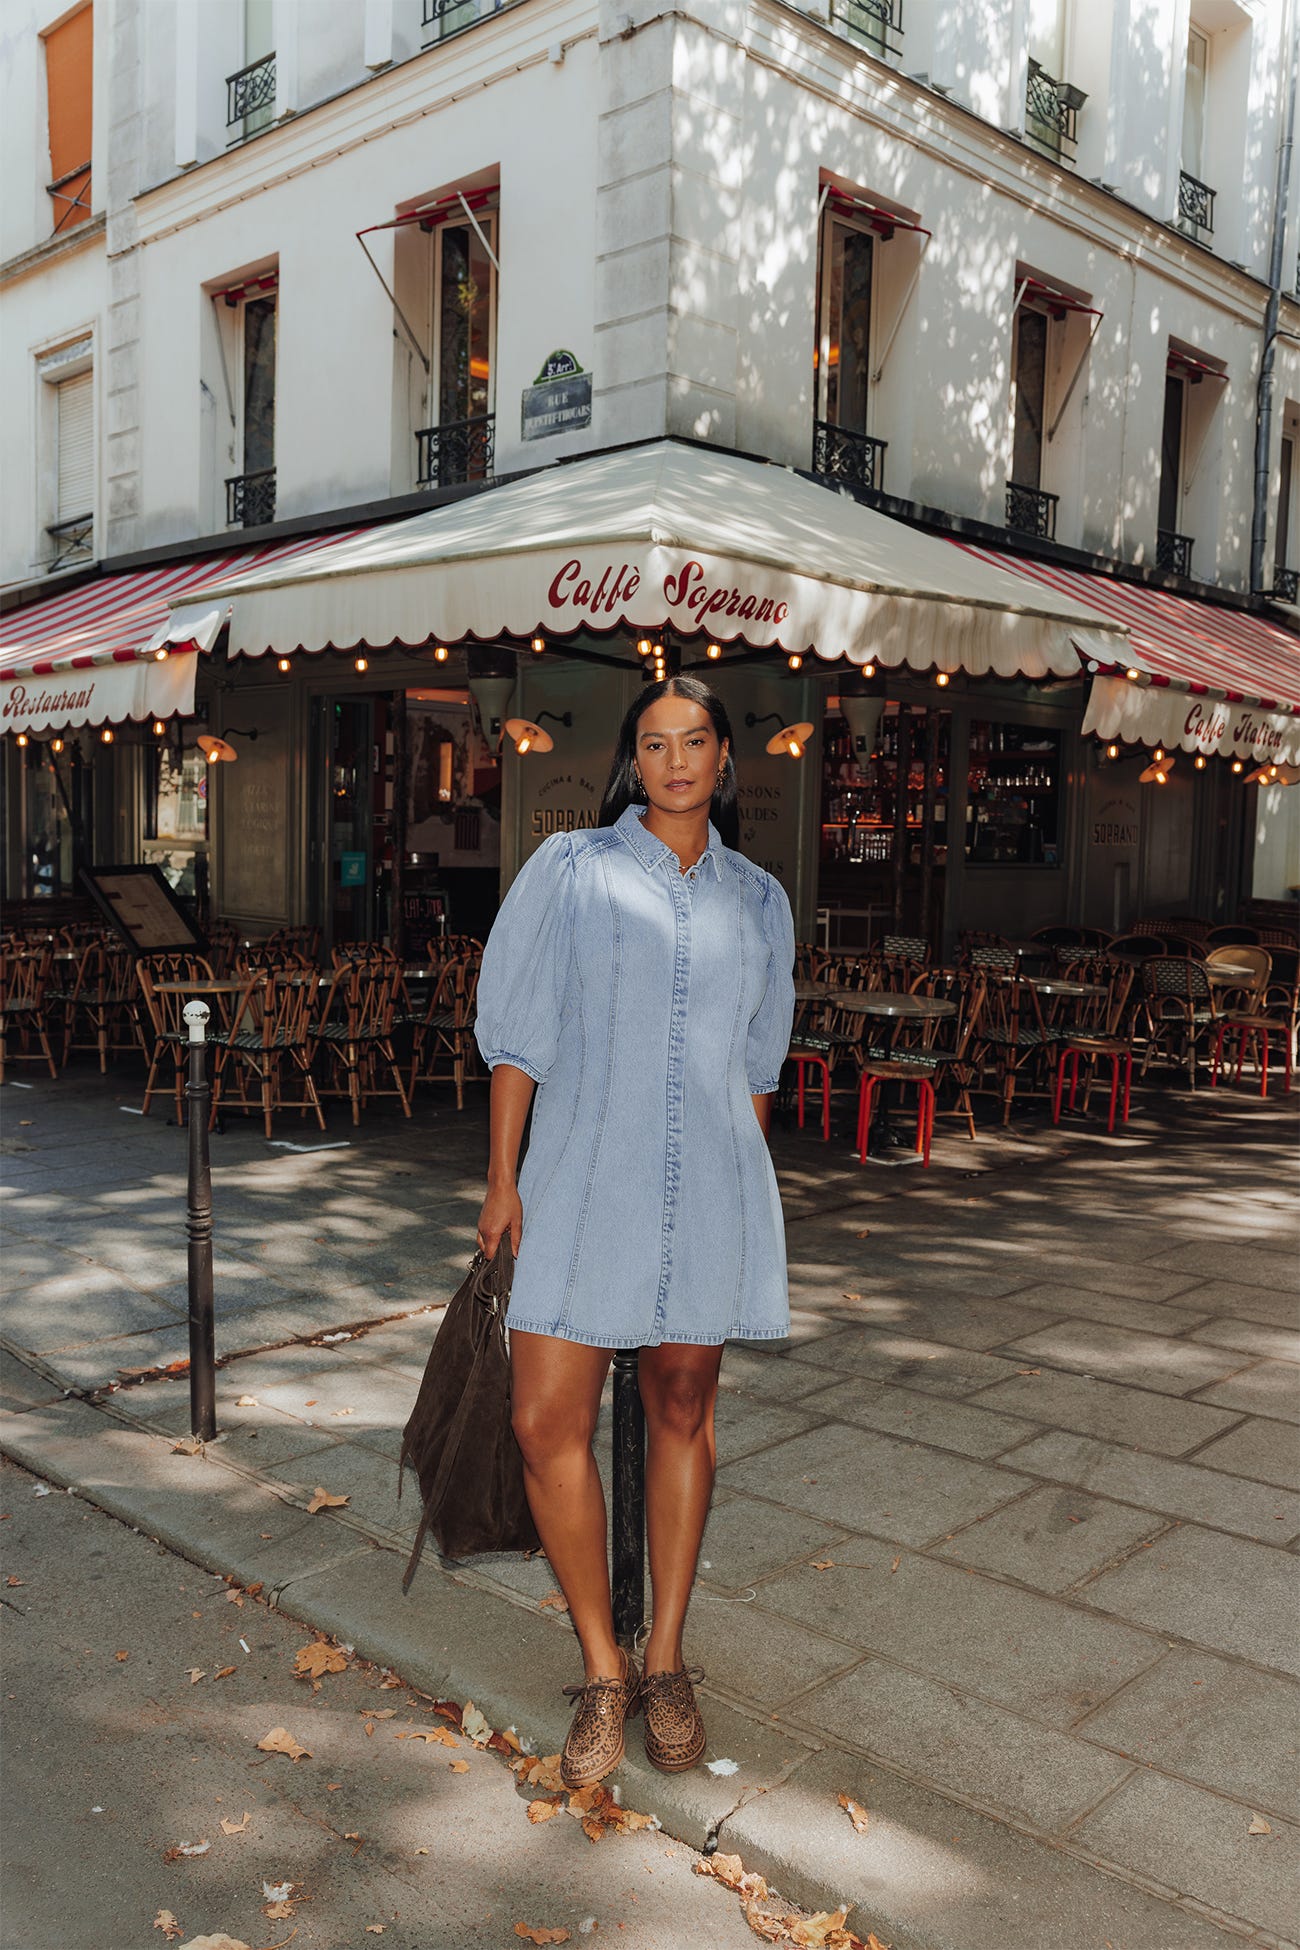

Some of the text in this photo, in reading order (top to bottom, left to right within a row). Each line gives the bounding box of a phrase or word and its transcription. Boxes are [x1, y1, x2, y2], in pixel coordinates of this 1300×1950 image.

[547, 392, 569, 407] RUE
[547, 559, 790, 625] Caffè Soprano
[2, 682, 96, 718] Restaurant
[1183, 703, 1284, 749] Caffè Italien
[531, 809, 601, 837] SOPRAN
[1091, 823, 1138, 847] SOPRANO
